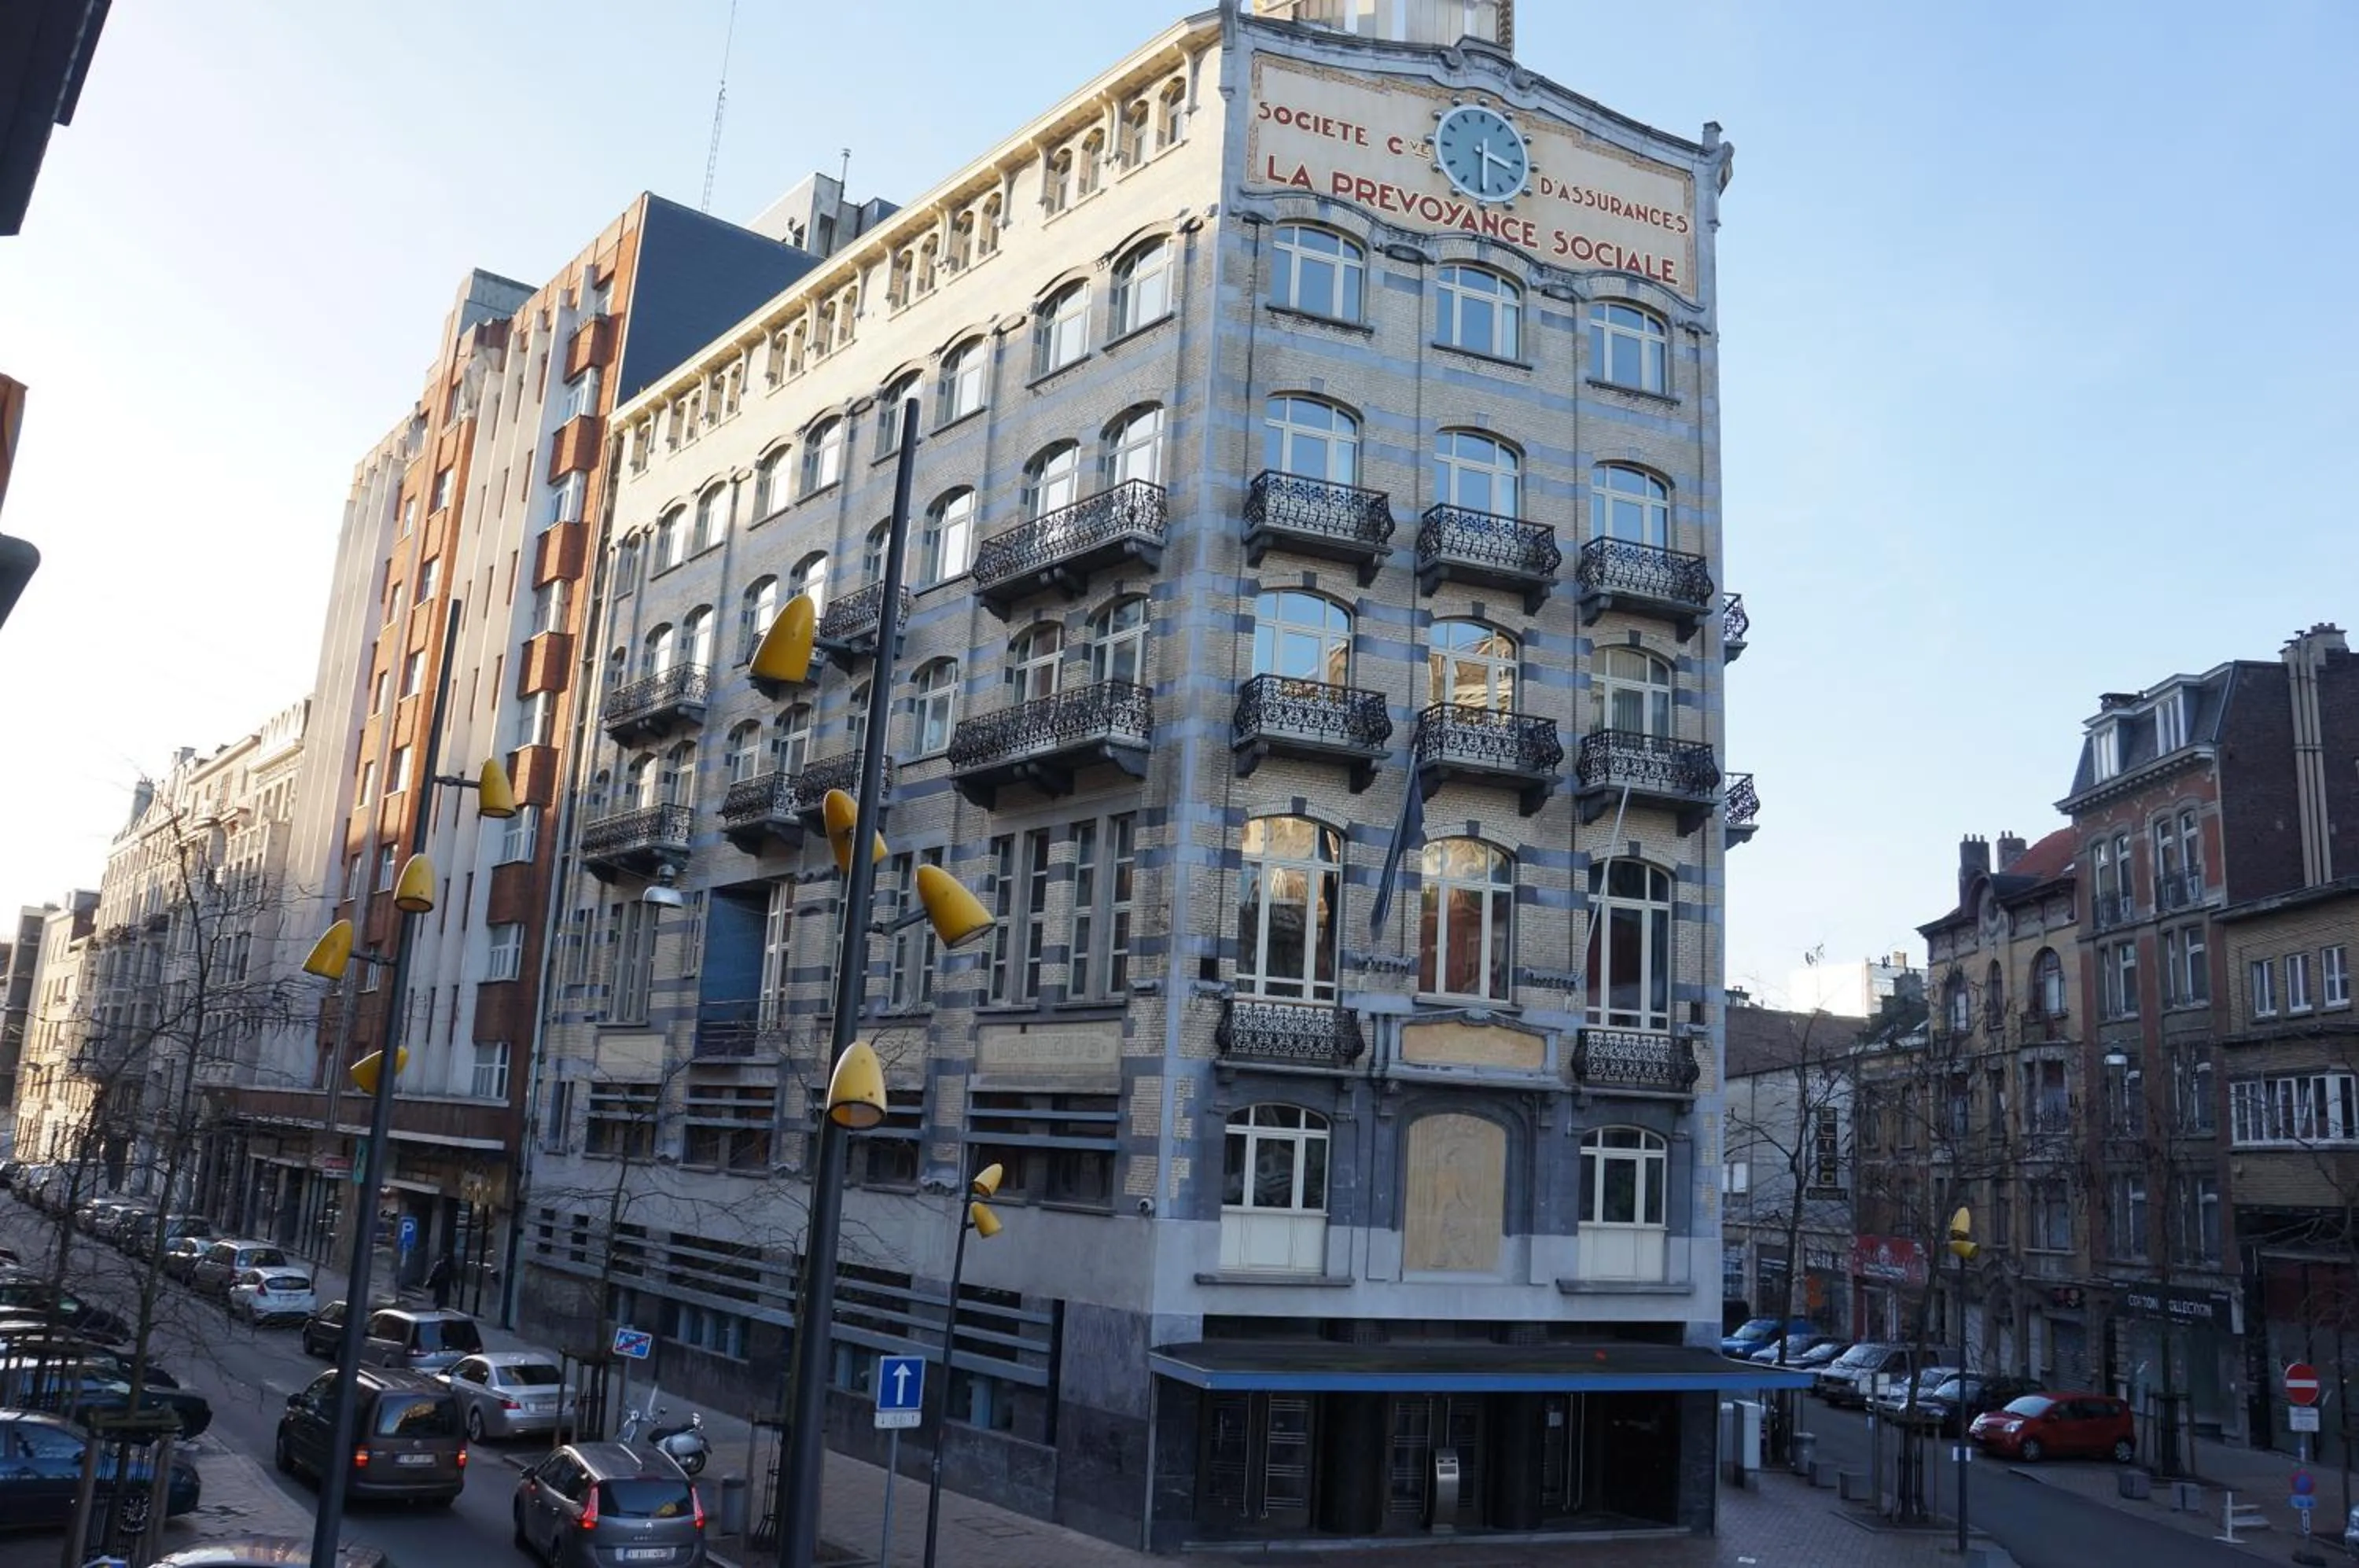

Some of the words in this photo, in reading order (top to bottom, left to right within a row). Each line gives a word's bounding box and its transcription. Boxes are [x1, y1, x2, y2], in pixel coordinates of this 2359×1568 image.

[1258, 101, 1369, 147] SOCIETE
[1268, 154, 1315, 191] LA
[1332, 171, 1538, 248] PREVOYANCE
[1554, 230, 1677, 285] SOCIALE
[1540, 177, 1688, 234] D'ASSURANCES
[401, 1221, 414, 1240] P
